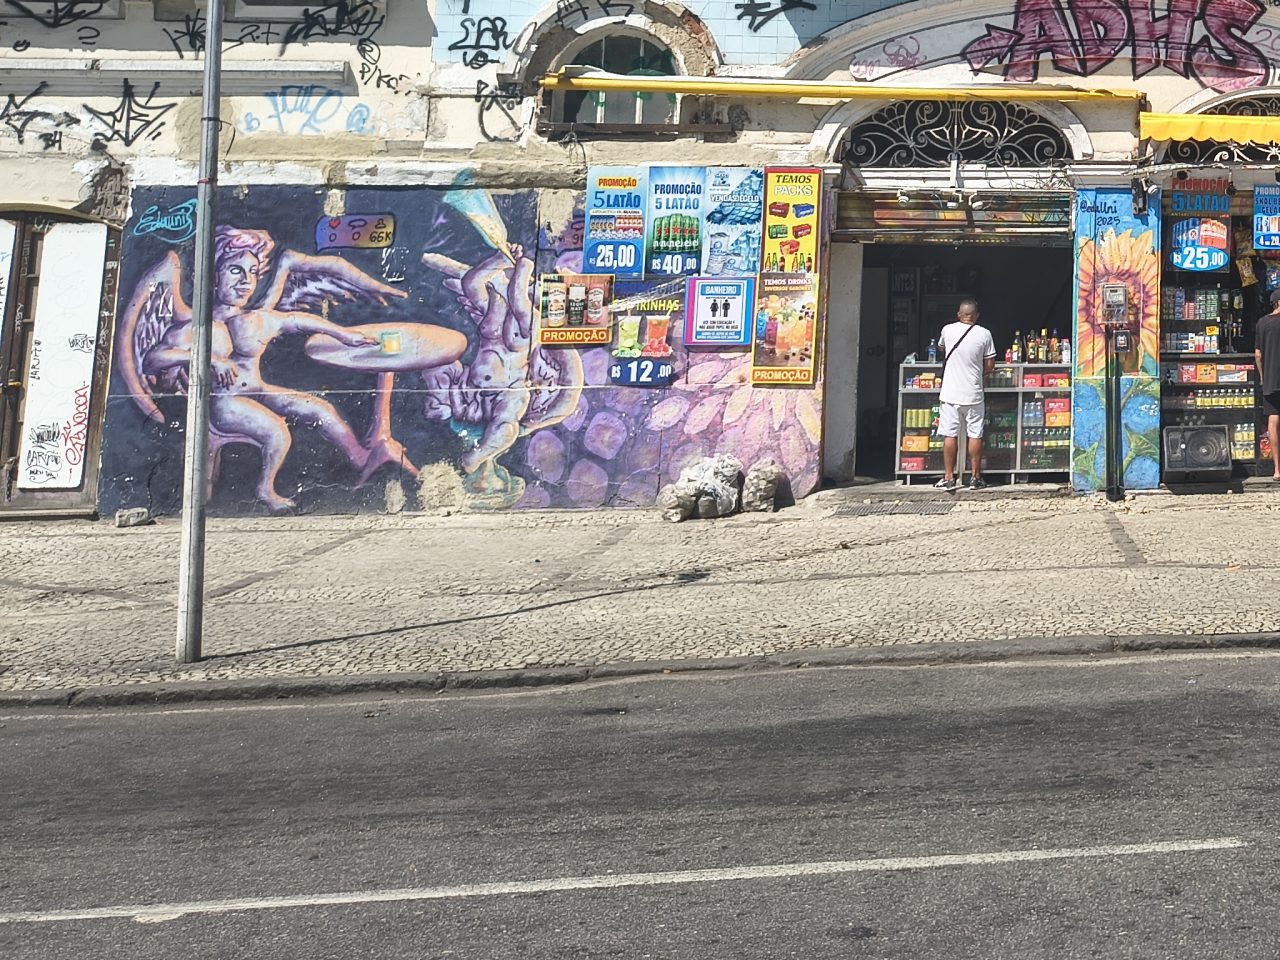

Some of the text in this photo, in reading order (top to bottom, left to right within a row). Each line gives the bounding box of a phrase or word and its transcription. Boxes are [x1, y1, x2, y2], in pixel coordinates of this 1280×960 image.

[598, 177, 637, 188] PROMOÇÃO
[776, 175, 812, 183] TEMOS
[655, 182, 702, 195] PROMOÇÃO
[774, 186, 813, 196] PACKS
[594, 191, 641, 208] 5 LATÃO
[655, 195, 699, 209] 5 LATÃO
[1172, 192, 1230, 212] 5 LATÃO
[1255, 197, 1271, 205] SKOL
[1097, 216, 1121, 226] 2025
[596, 244, 635, 269] 25,00
[1183, 247, 1224, 268] 25,00
[652, 258, 661, 270] R$
[764, 278, 812, 286] TEMOS DRINKS
[705, 285, 737, 295] BANHEIRO
[543, 330, 607, 342] PROMOÇÃO
[611, 365, 621, 378] R$
[754, 368, 808, 381] PROMOÇÃO
